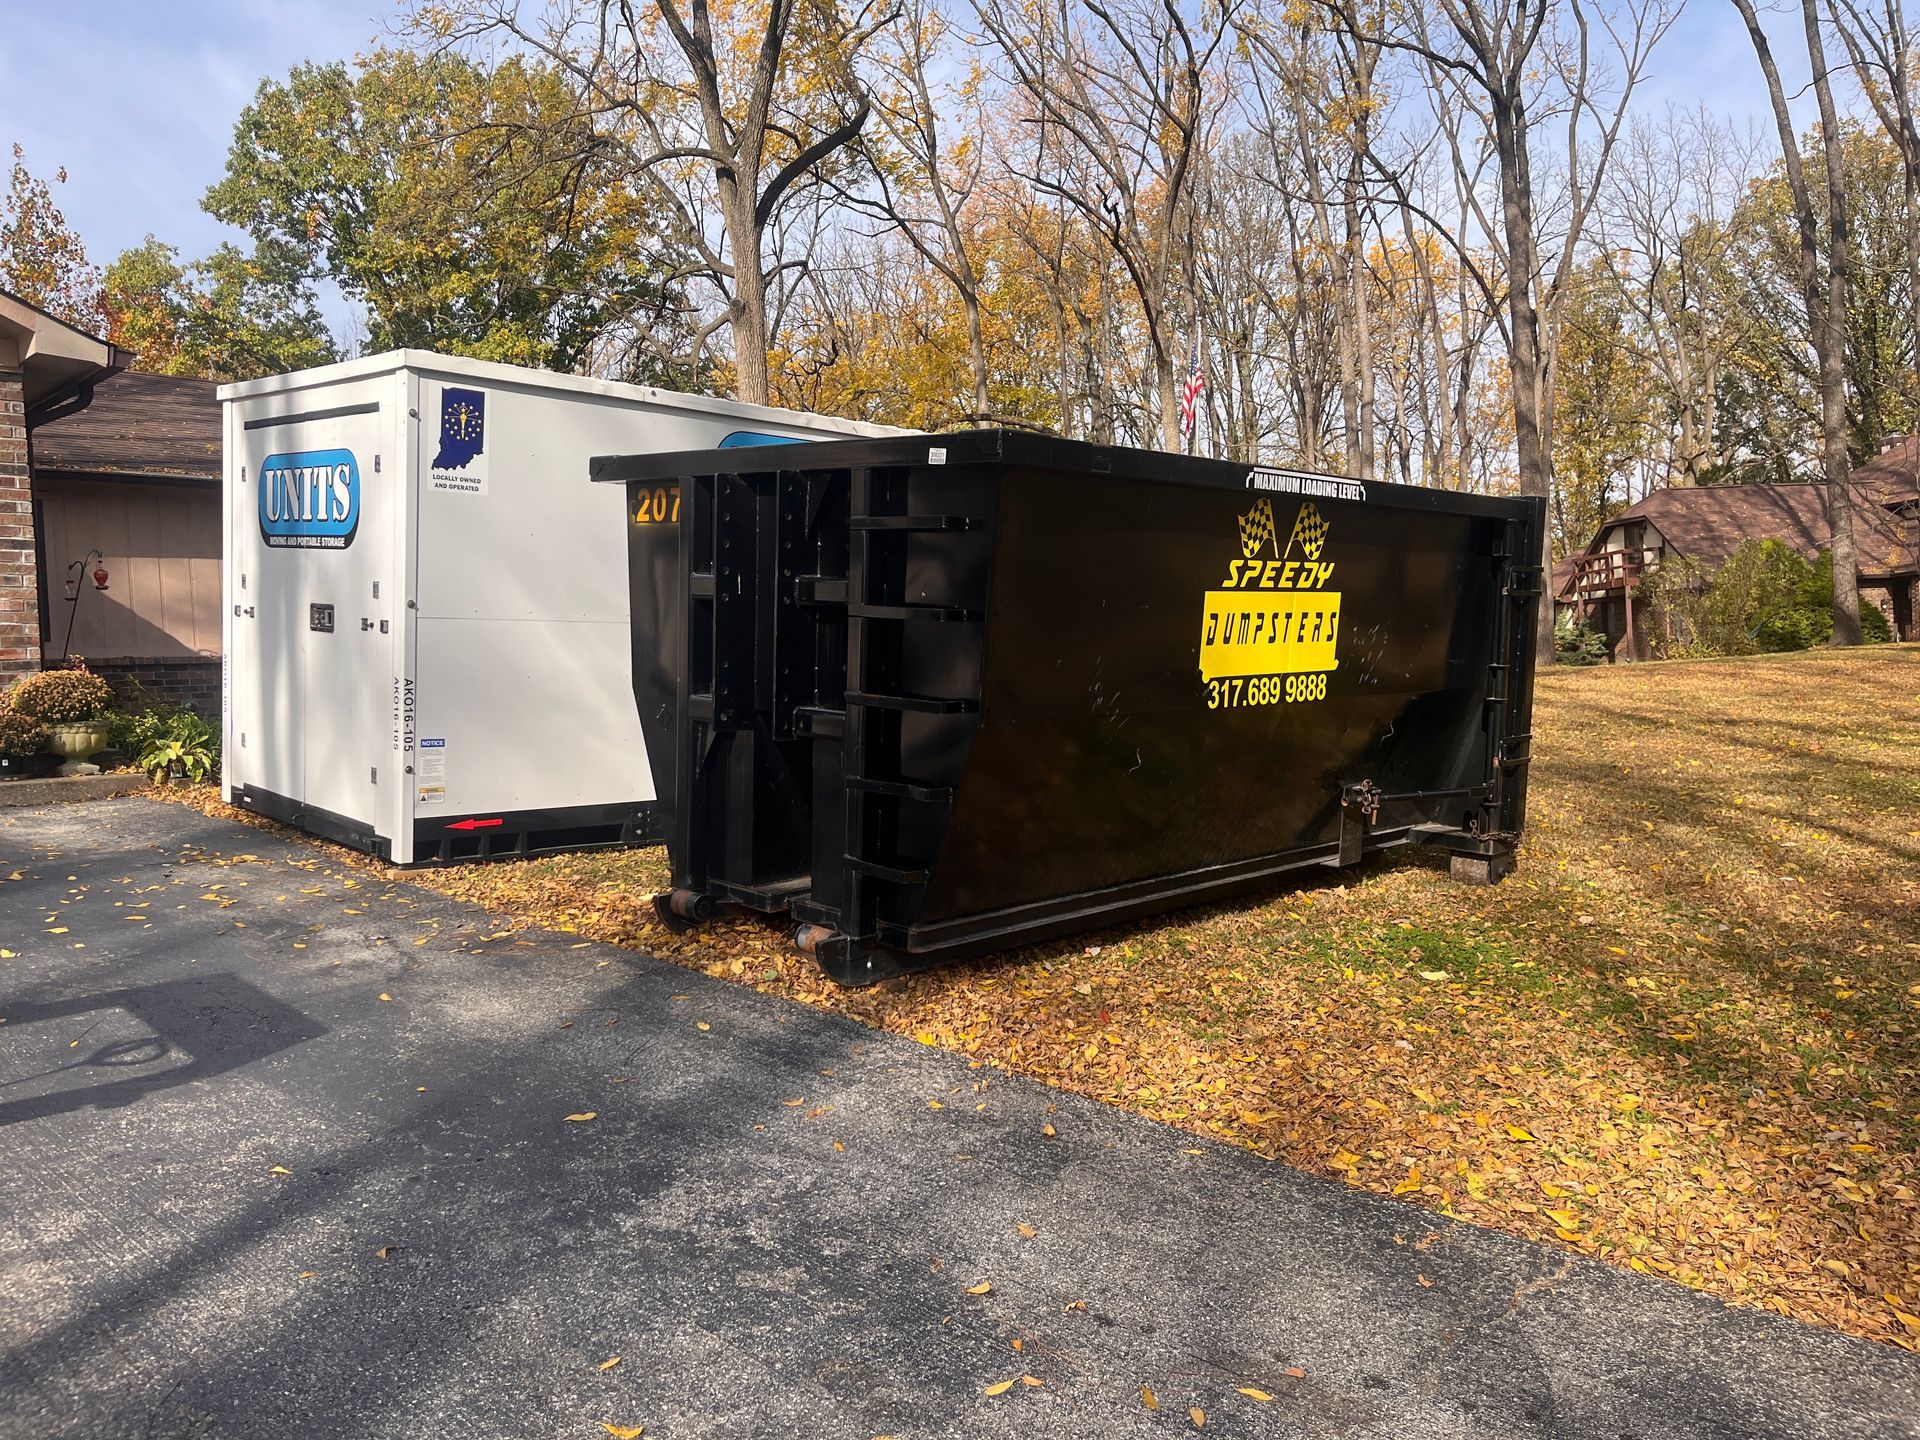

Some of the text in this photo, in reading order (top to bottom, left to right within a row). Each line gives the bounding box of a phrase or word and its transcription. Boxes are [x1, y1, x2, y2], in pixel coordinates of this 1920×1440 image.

[265, 463, 351, 522] UNITS
[432, 474, 459, 482] LOCALLY
[448, 484, 480, 492] OPERATED
[1253, 473, 1361, 501] MAXIMUM LOADING LEVEL
[636, 487, 680, 522] 207
[287, 537, 297, 545] AND
[297, 537, 321, 546] PORTABLE
[321, 537, 345, 547] STORAGE
[1222, 560, 1336, 589] SPEEDY
[1205, 612, 1337, 646] DUMPSTERS
[1207, 673, 1327, 710] 317.689 9888
